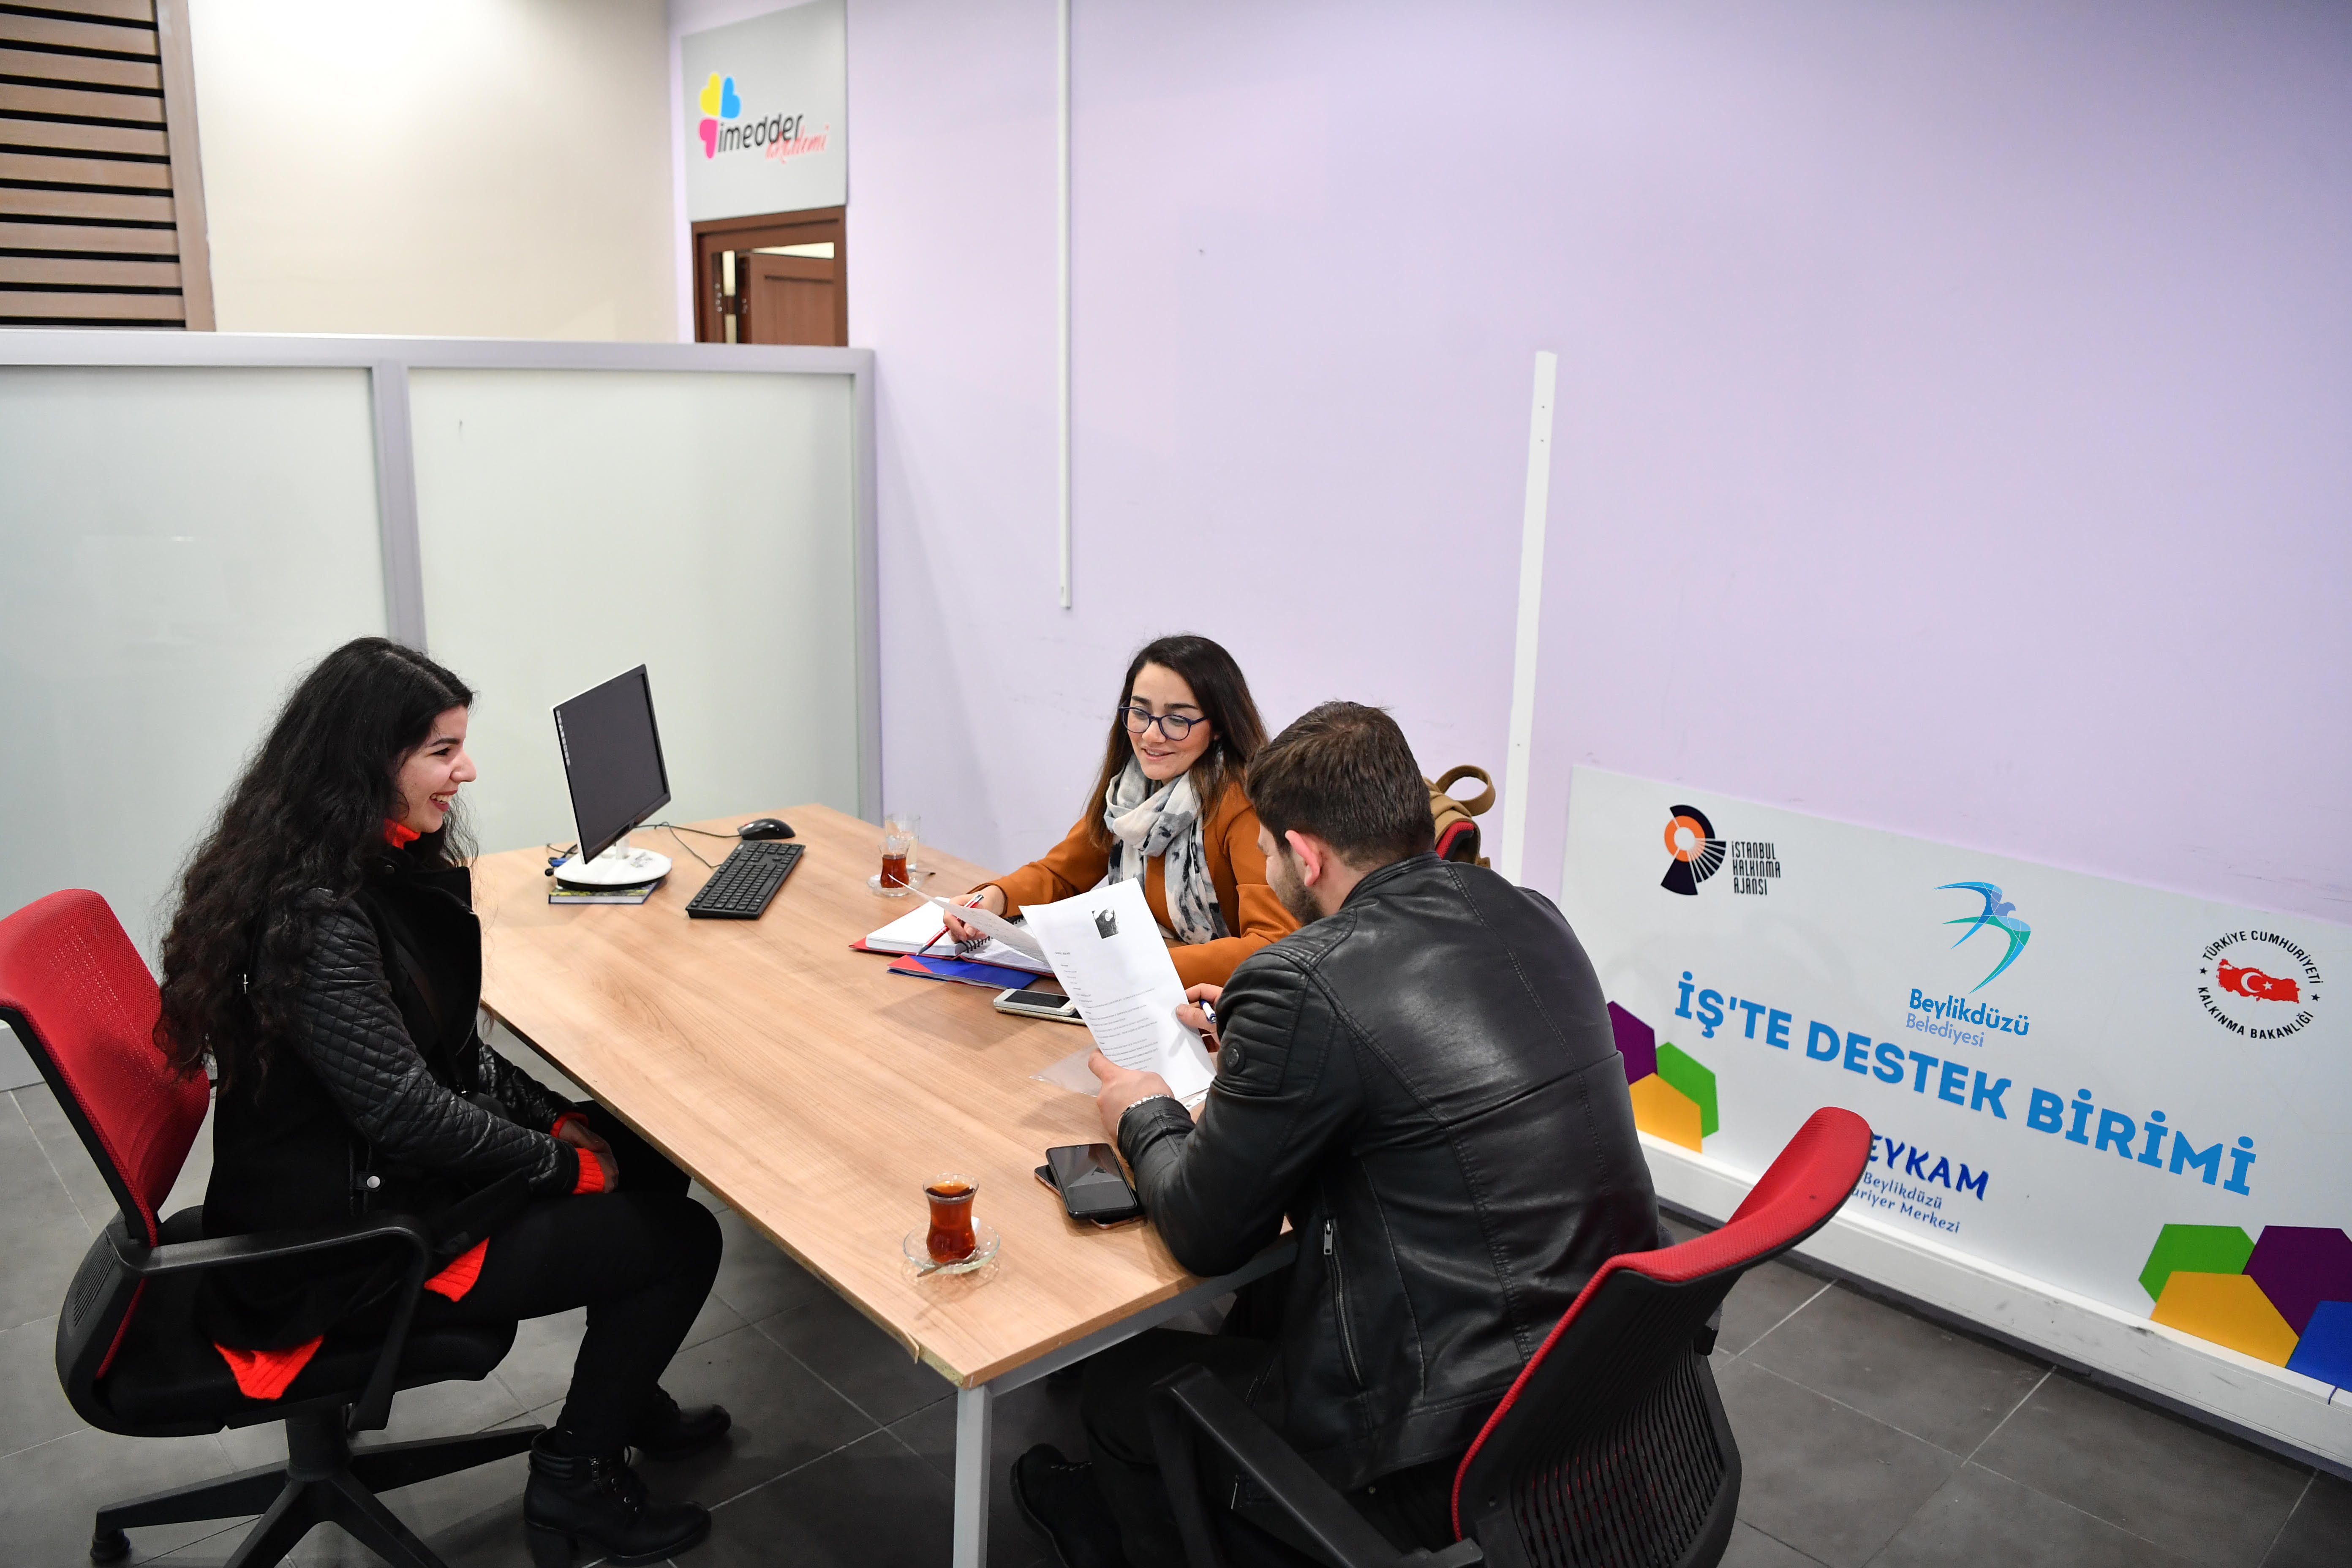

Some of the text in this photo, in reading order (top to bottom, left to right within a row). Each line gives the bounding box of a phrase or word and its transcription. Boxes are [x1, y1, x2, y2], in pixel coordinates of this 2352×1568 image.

[718, 113, 804, 152] imedder
[1733, 859, 1781, 878] KALKINMA
[1734, 877, 1767, 896] AJANSI
[2202, 930, 2324, 984] TÜRKİYE CUMHURİYETİ
[1906, 1013, 1984, 1047] Belediyesi
[1909, 988, 2029, 1036] Beylikdüzü
[2197, 986, 2314, 1040] KALKINMA BAKANLIĞI
[1675, 971, 2256, 1196] İŞ'TE DESTEK BİRİMİ
[1863, 1171, 1943, 1210] Beylikdüzü
[1869, 1134, 1989, 1201] EYKAM
[1852, 1188, 1960, 1234] ariyer Merkezi
